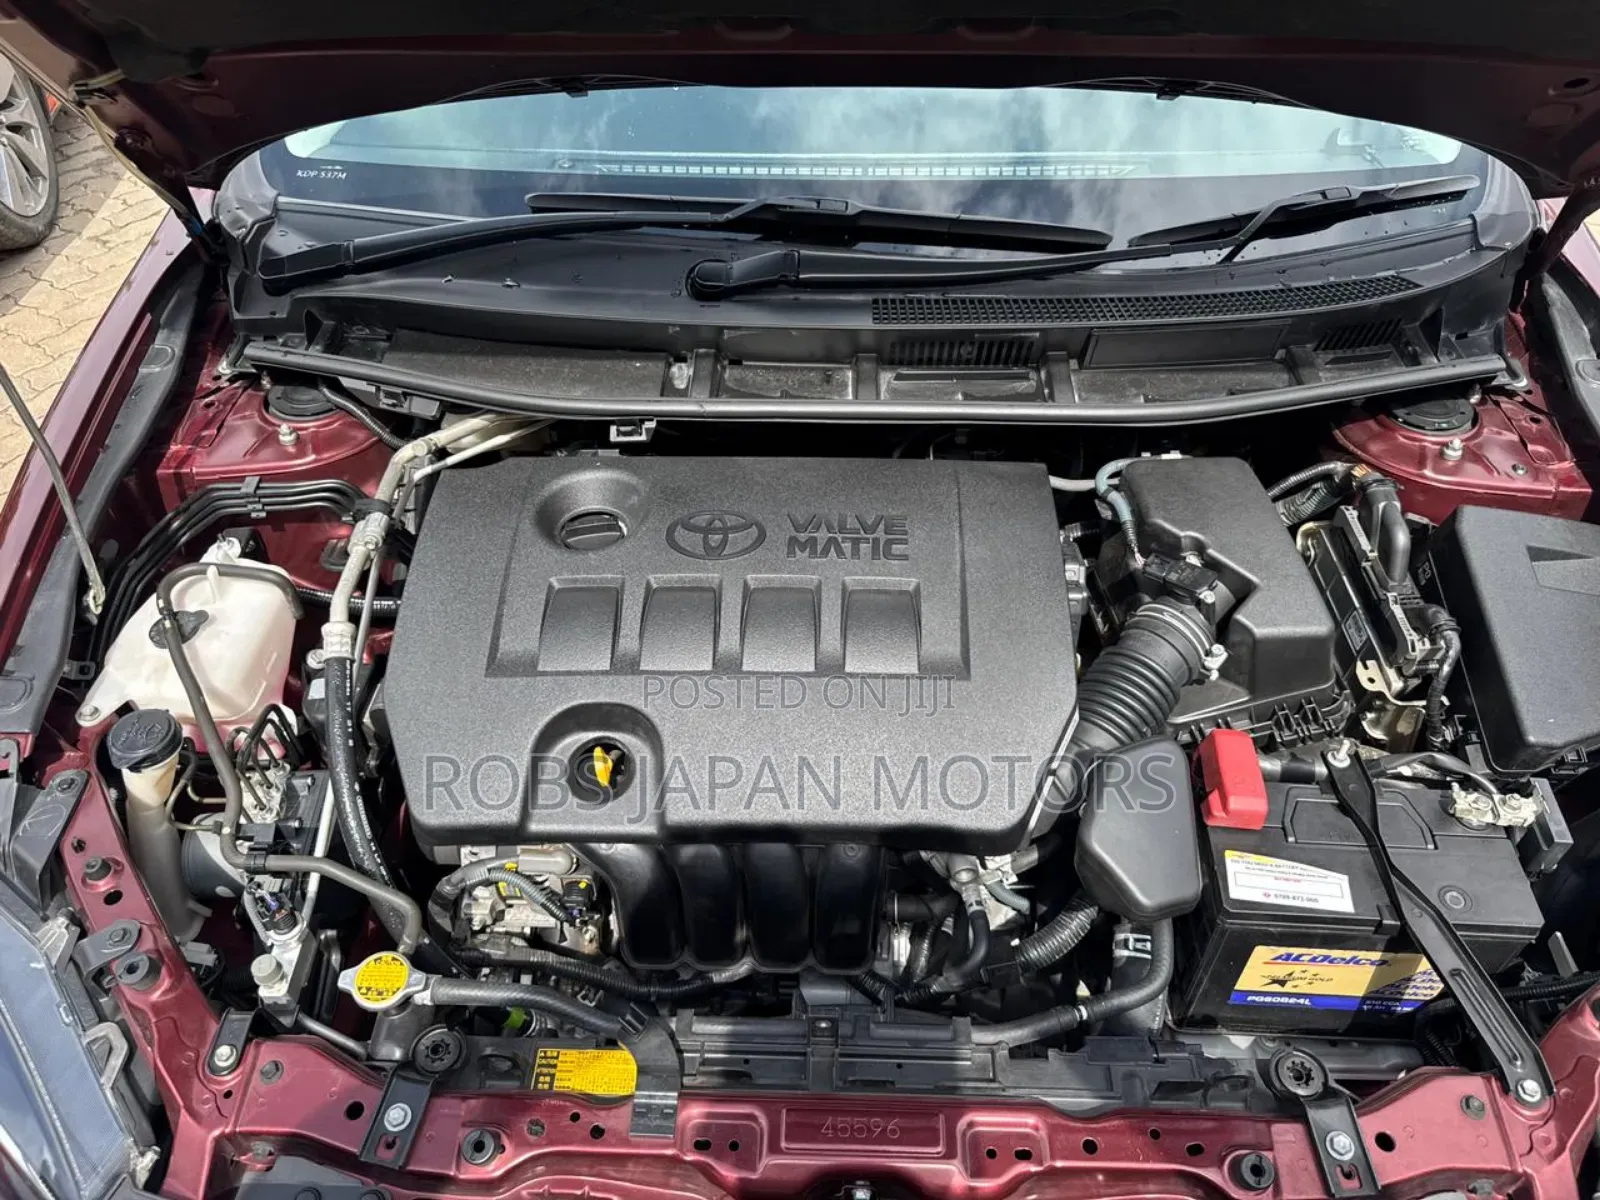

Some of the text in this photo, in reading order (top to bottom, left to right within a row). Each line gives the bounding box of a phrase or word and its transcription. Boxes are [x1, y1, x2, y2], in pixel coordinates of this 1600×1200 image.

[296, 170, 348, 180] KDP 537M
[787, 512, 909, 535] VALVE
[786, 535, 909, 561] MATIC
[1271, 952, 1389, 966] ACDelco
[820, 1116, 901, 1139] 45596
